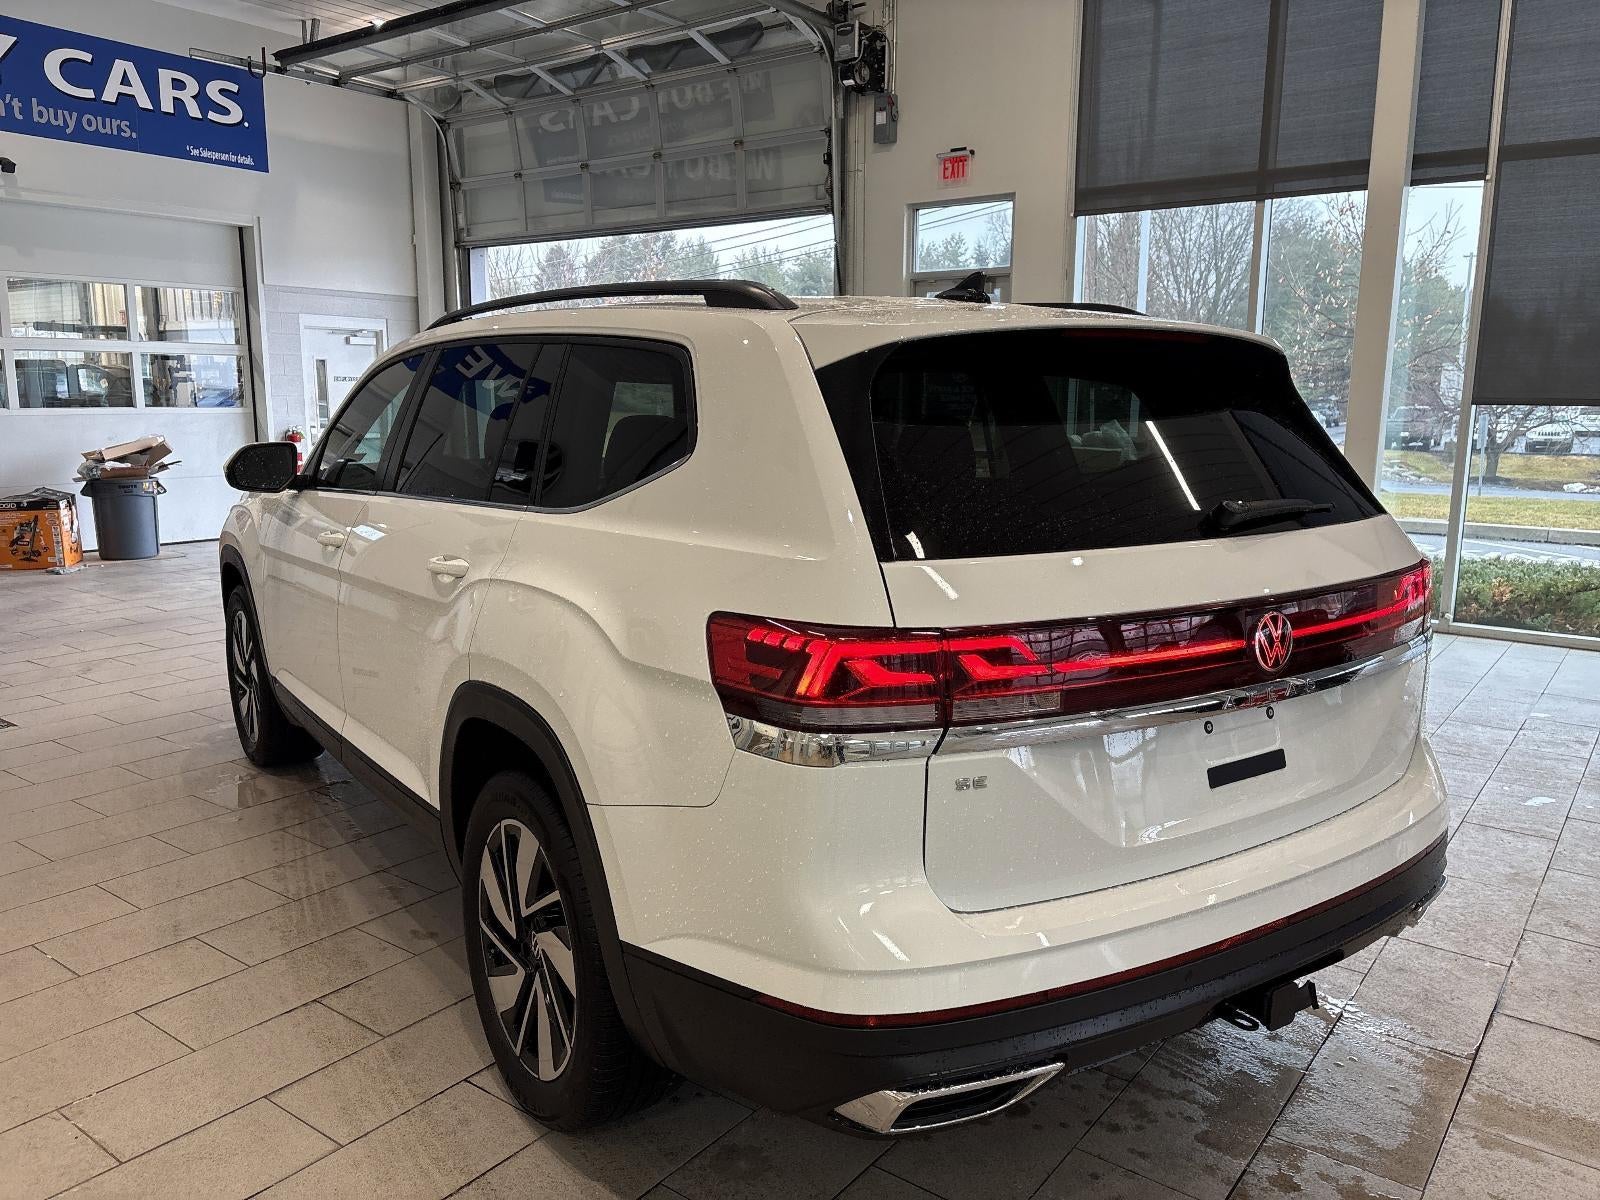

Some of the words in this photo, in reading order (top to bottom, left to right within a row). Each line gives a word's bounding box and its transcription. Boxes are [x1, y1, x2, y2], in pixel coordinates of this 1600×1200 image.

[44, 48, 249, 127] CARS.
[32, 98, 77, 134] buy
[82, 114, 137, 139] ours.
[190, 146, 199, 156] See
[200, 147, 229, 161] Salesperson
[229, 152, 237, 162] for
[943, 156, 967, 179] EXIT
[1221, 678, 1316, 709] ATLAS
[955, 776, 988, 791] SE
